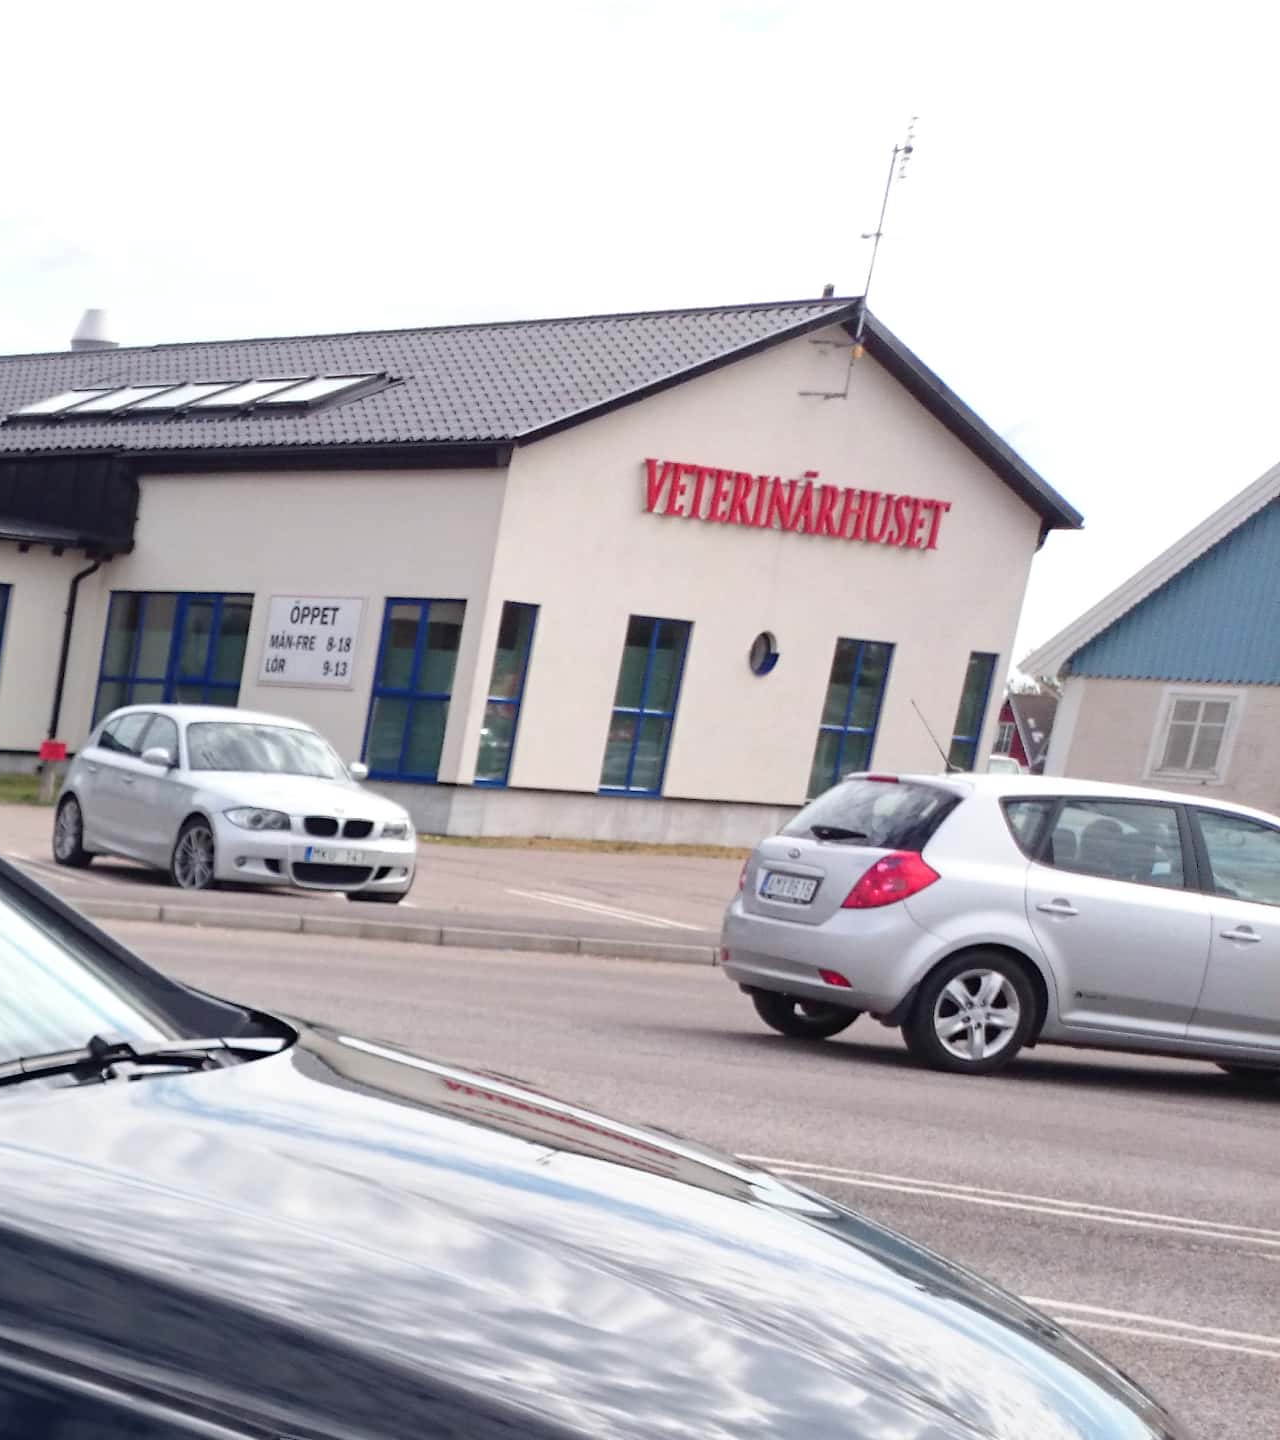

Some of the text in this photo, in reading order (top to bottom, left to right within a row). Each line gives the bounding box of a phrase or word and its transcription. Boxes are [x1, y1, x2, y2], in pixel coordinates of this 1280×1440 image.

[643, 458, 952, 550] VETERINÄRHUSET
[289, 600, 340, 626] ÖPPET
[326, 636, 352, 654] 8-18
[264, 655, 348, 678] LÖR 9-13
